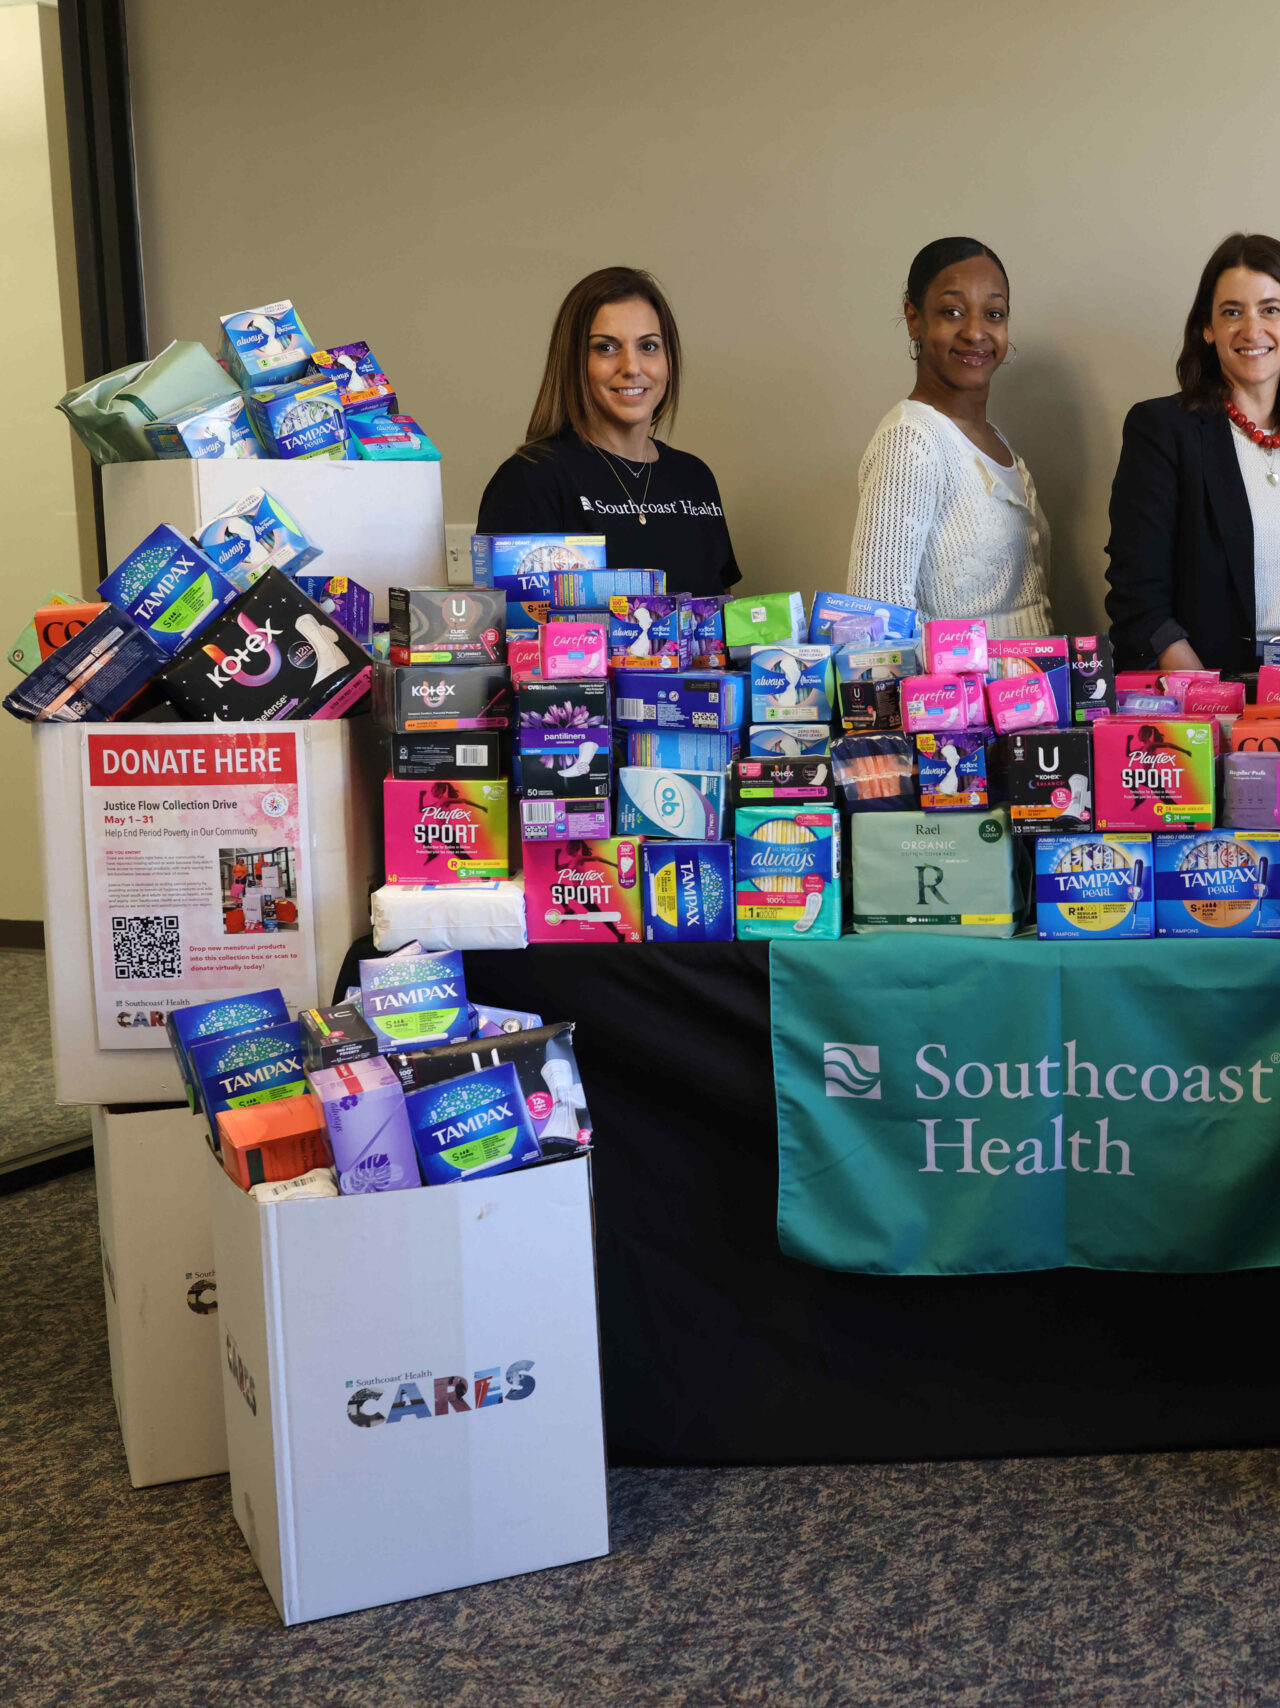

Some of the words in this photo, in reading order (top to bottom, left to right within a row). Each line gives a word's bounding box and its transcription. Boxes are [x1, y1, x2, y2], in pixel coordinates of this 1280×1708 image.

[236, 333, 264, 347] always
[282, 421, 337, 449] TAMPAX
[595, 500, 677, 514] Southcoast
[679, 500, 723, 517] Health
[218, 540, 246, 565] always
[134, 554, 195, 620] TAMPAX
[518, 573, 551, 590] TAM
[452, 600, 466, 617] U
[826, 596, 845, 606] Sure
[851, 600, 872, 612] Fresh
[42, 620, 85, 649] CO
[612, 629, 638, 640] always
[1003, 646, 1034, 654] PAQUET
[1035, 646, 1054, 654] DUO
[754, 674, 785, 689] always
[544, 732, 586, 741] pantiliners
[103, 749, 206, 774] DONATE
[215, 748, 282, 773] HERE
[1038, 746, 1059, 772] U
[1129, 751, 1177, 768] Playtex
[920, 767, 947, 779] always
[1122, 768, 1185, 789] SPORT
[104, 801, 136, 811] Justice
[138, 801, 160, 810] Flow
[162, 800, 210, 810] Collection
[212, 800, 237, 809] Drive
[421, 806, 472, 822] Playtex
[104, 816, 126, 825] May
[1165, 814, 1171, 822] S
[105, 829, 122, 838] Help
[124, 828, 137, 837] End
[139, 828, 162, 837] Period
[163, 828, 190, 838] Poverty
[191, 827, 198, 836] in
[200, 827, 214, 836] Our
[215, 827, 258, 837] Community
[414, 824, 479, 844] SPORT
[916, 823, 940, 835] Rael
[901, 840, 957, 850] ORGANIC
[751, 847, 815, 873] always
[557, 869, 605, 883] Playtex
[914, 863, 950, 905] R
[1055, 871, 1132, 891] TAMPAX
[1180, 867, 1257, 888] TAMPAX
[551, 885, 613, 905] SPORT
[680, 860, 700, 927] TAMPAX
[749, 908, 753, 918] 1
[1069, 907, 1075, 916] R
[370, 983, 459, 1012] TAMPAX
[117, 1011, 174, 1027] CAR
[219, 1056, 301, 1093] TAMPAX
[432, 1103, 514, 1146] TAMPAX
[916, 1113, 1136, 1177] Health
[356, 1374, 402, 1387] Southcoast
[405, 1369, 433, 1380] Health
[347, 1359, 536, 1428] CARES
